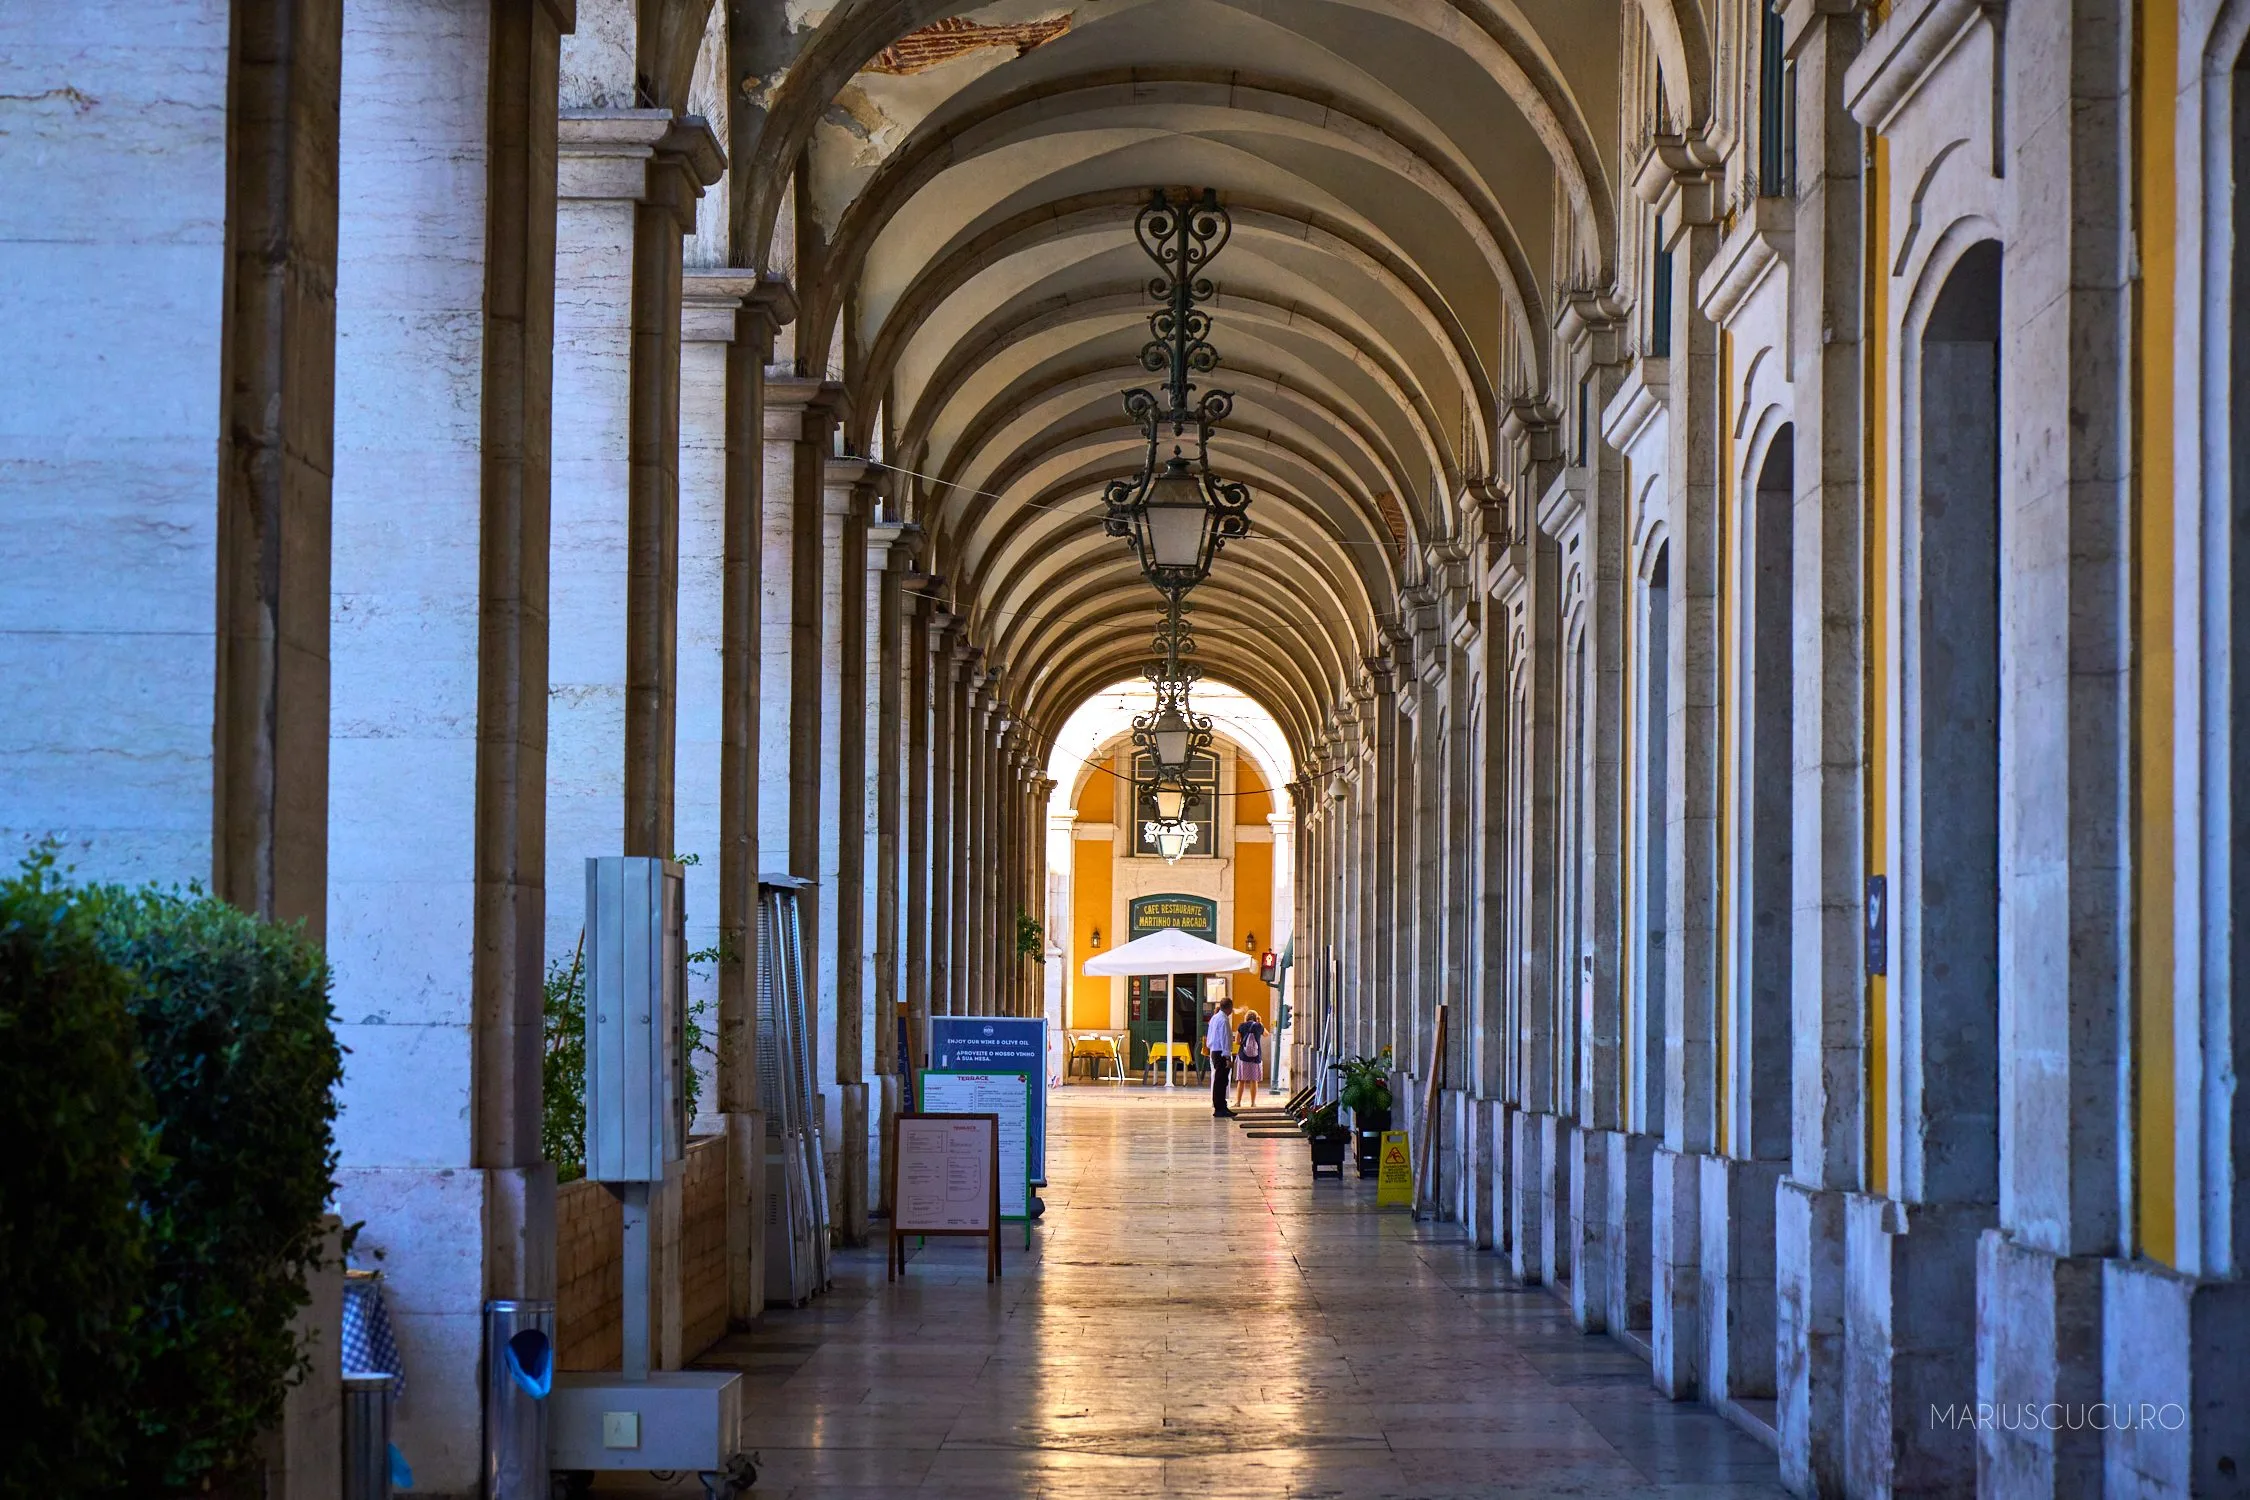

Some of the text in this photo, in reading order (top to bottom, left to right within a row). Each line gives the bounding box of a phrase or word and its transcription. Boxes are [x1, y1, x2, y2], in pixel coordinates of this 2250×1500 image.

[1161, 903, 1203, 916] RESTAURANTE
[1139, 916, 1207, 928] MARTINHO DA ARCADA
